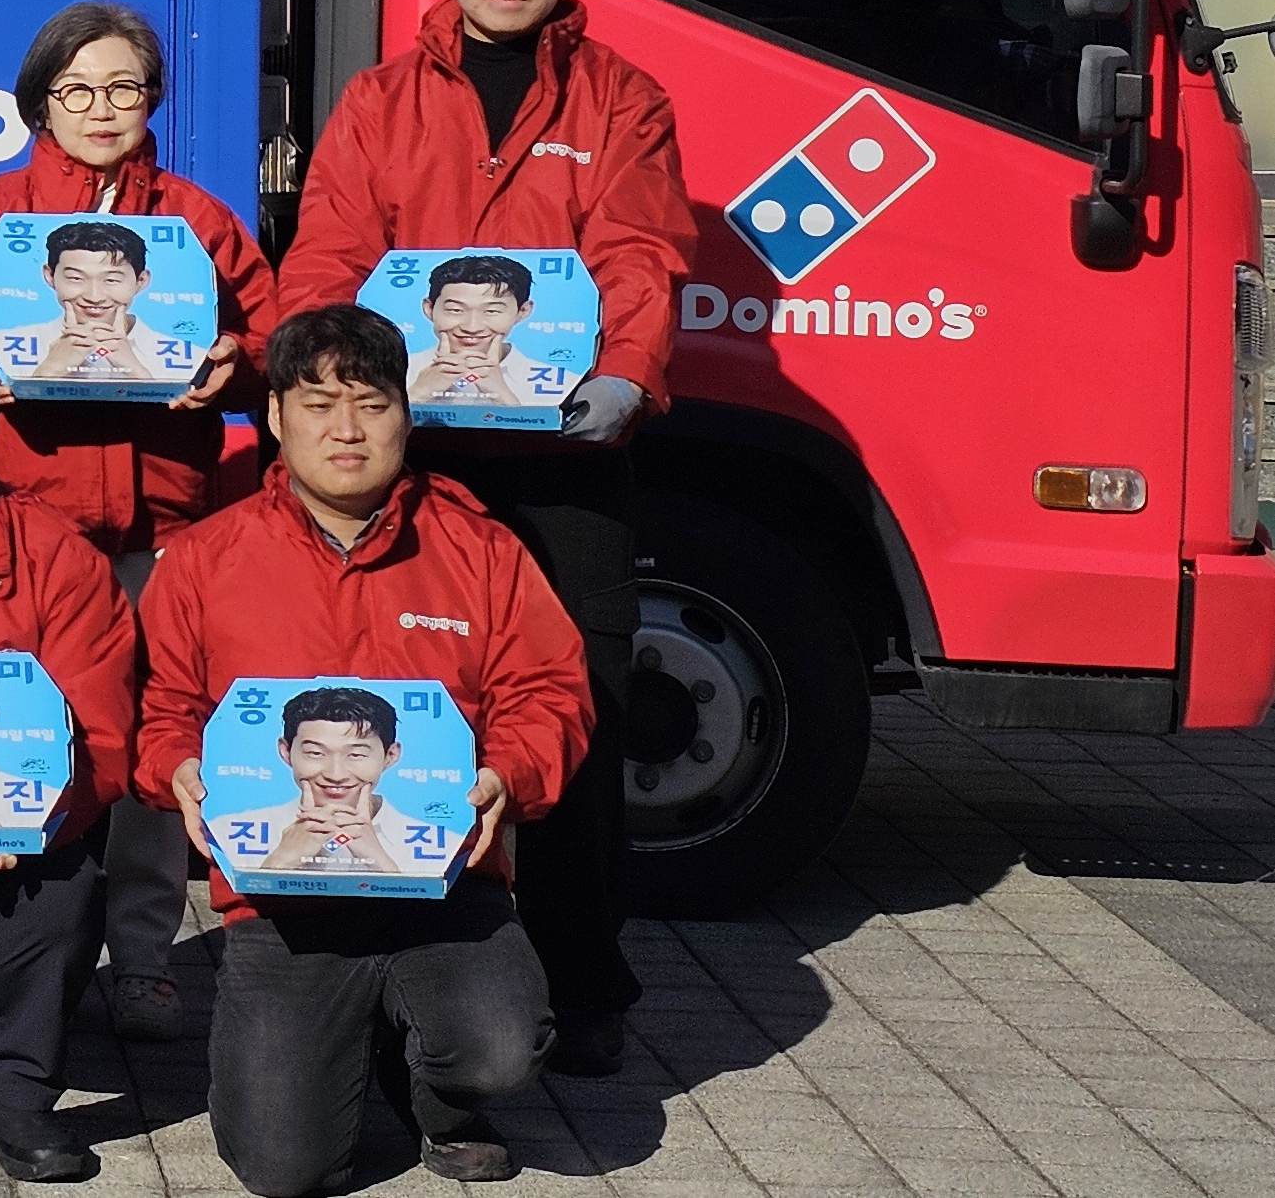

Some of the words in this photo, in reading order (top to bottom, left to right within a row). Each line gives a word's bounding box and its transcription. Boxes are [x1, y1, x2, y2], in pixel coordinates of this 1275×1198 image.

[3, 220, 37, 253] 흥
[151, 225, 185, 250] 미
[386, 257, 420, 288] 흥
[538, 257, 575, 281] 미
[3, 336, 39, 366] 진
[156, 340, 193, 370] 진
[527, 366, 565, 395] 진
[233, 687, 272, 725] 흥
[403, 691, 441, 719] 미
[3, 780, 44, 813] 진
[228, 821, 272, 855] 진
[404, 825, 446, 860] 진
